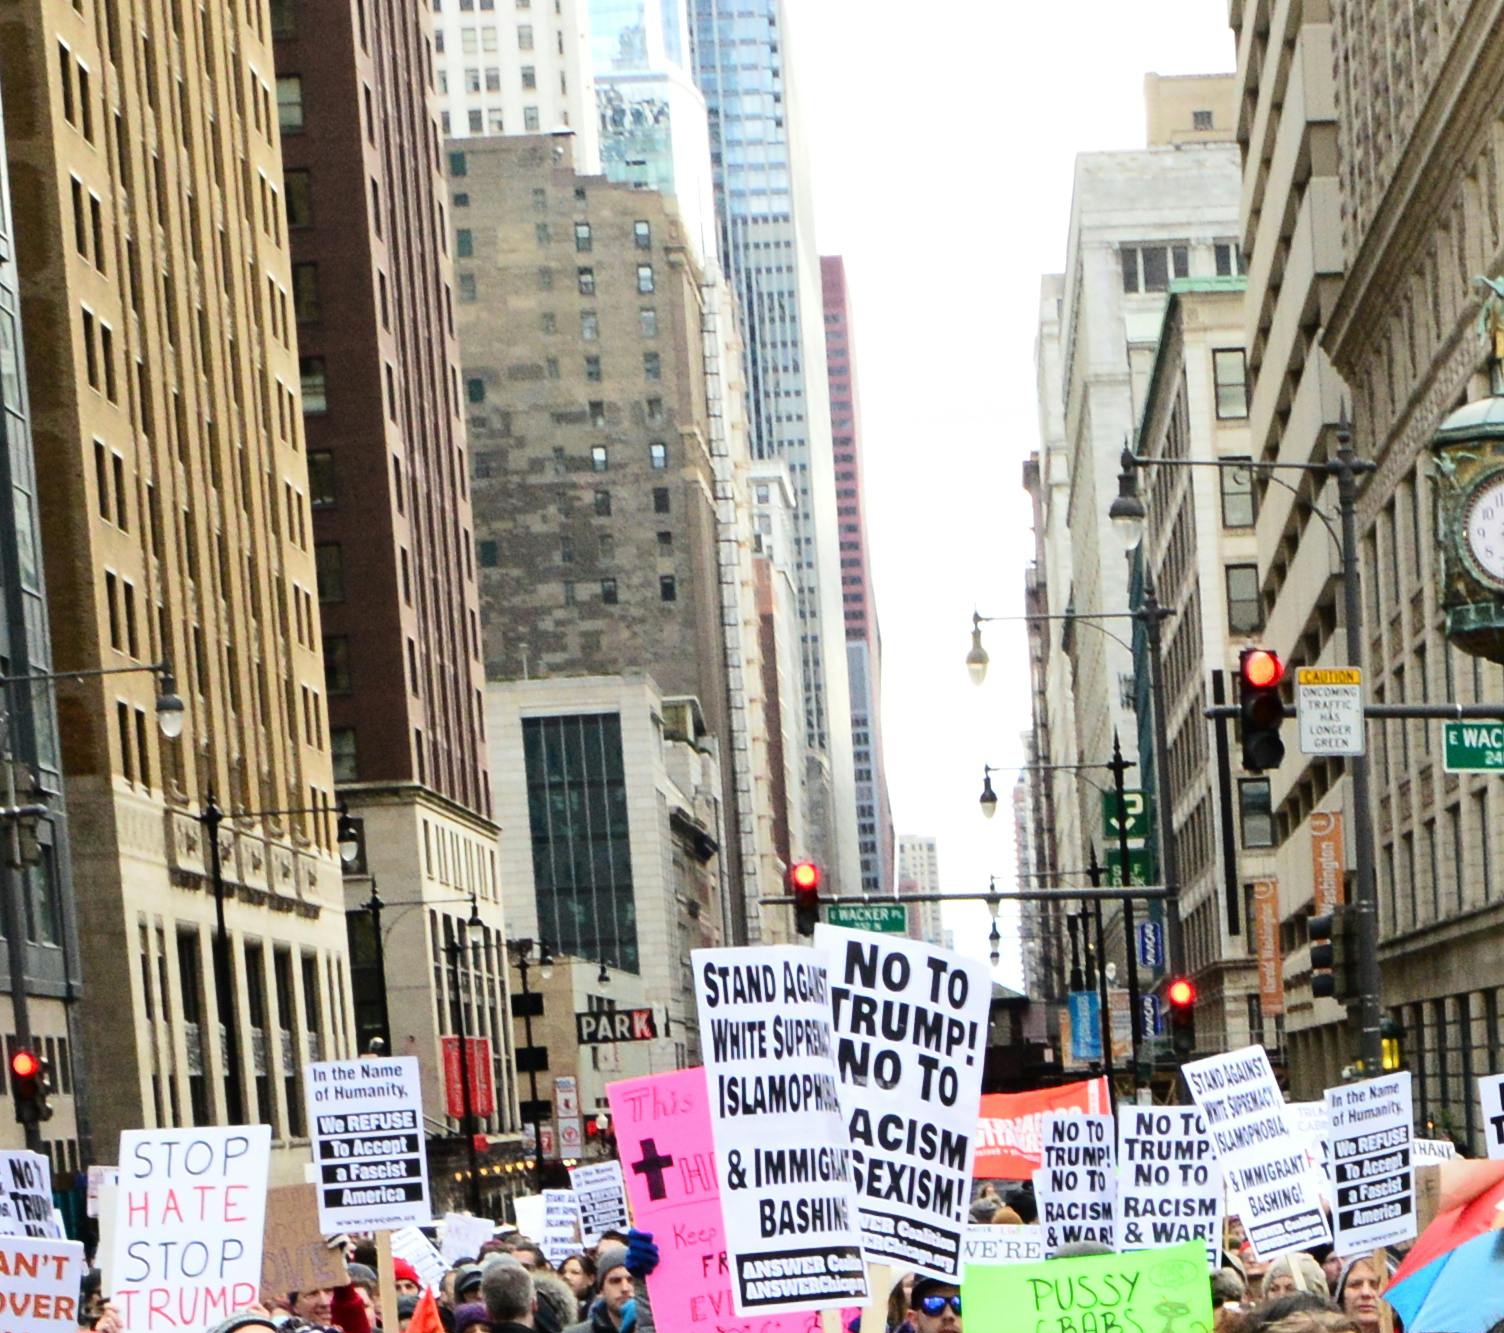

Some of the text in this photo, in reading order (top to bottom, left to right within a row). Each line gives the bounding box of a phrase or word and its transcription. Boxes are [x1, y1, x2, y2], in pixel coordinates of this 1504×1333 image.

[1305, 670, 1354, 683] CAUTION
[1302, 687, 1357, 698] ONCOMING
[1308, 700, 1351, 711] TRAFFIC
[1319, 712, 1341, 723] HAS
[1309, 725, 1352, 736] LONGER
[1449, 731, 1457, 745] E
[1314, 737, 1349, 748] GREEN
[838, 909, 889, 921] WACKER
[704, 962, 776, 1008] STAND
[845, 940, 968, 1009] NO TO
[581, 1010, 653, 1041] PARK
[831, 986, 978, 1066] TRUMP!
[711, 1019, 766, 1062] WHITE
[313, 1064, 402, 1082] In the Name
[838, 1038, 958, 1106] NO TO
[1191, 1057, 1267, 1095] STAND AGAINST
[315, 1083, 408, 1102] of Humanity,
[1332, 1082, 1399, 1108] In the Name
[624, 1086, 692, 1122] This
[319, 1111, 414, 1133] We REFUSE
[1136, 1113, 1207, 1135] NO TO
[1333, 1113, 1344, 1126] of
[849, 1108, 968, 1171] ACISM
[1052, 1121, 1079, 1142] NO
[1087, 1120, 1104, 1142] TO
[1336, 1127, 1407, 1156] We REFUSE
[134, 1136, 249, 1178] STOP
[331, 1136, 407, 1157] To Accept
[1045, 1146, 1110, 1168] TRUMP!
[350, 1161, 407, 1179] Fascist
[728, 1150, 746, 1190] &
[1135, 1164, 1208, 1186] NO TO
[1240, 1154, 1305, 1188] IMMIGRANT
[1345, 1153, 1403, 1178] To Accept
[1052, 1169, 1105, 1192] NO TO
[1360, 1178, 1403, 1200] Fascist
[129, 1185, 248, 1227] HATE
[342, 1186, 406, 1205] America
[1248, 1182, 1305, 1217] BASHING!
[1045, 1202, 1112, 1222] RACISM
[1124, 1197, 1216, 1218] RACISM
[1353, 1204, 1401, 1226] America
[674, 1224, 716, 1249] Keep
[1063, 1225, 1113, 1245] WAR!
[1125, 1222, 1214, 1244] & WAR!
[126, 1238, 244, 1282] STOP
[743, 1256, 825, 1280] ANSWER
[1027, 1271, 1140, 1311] PUSSY
[117, 1283, 255, 1330] TRUMP
